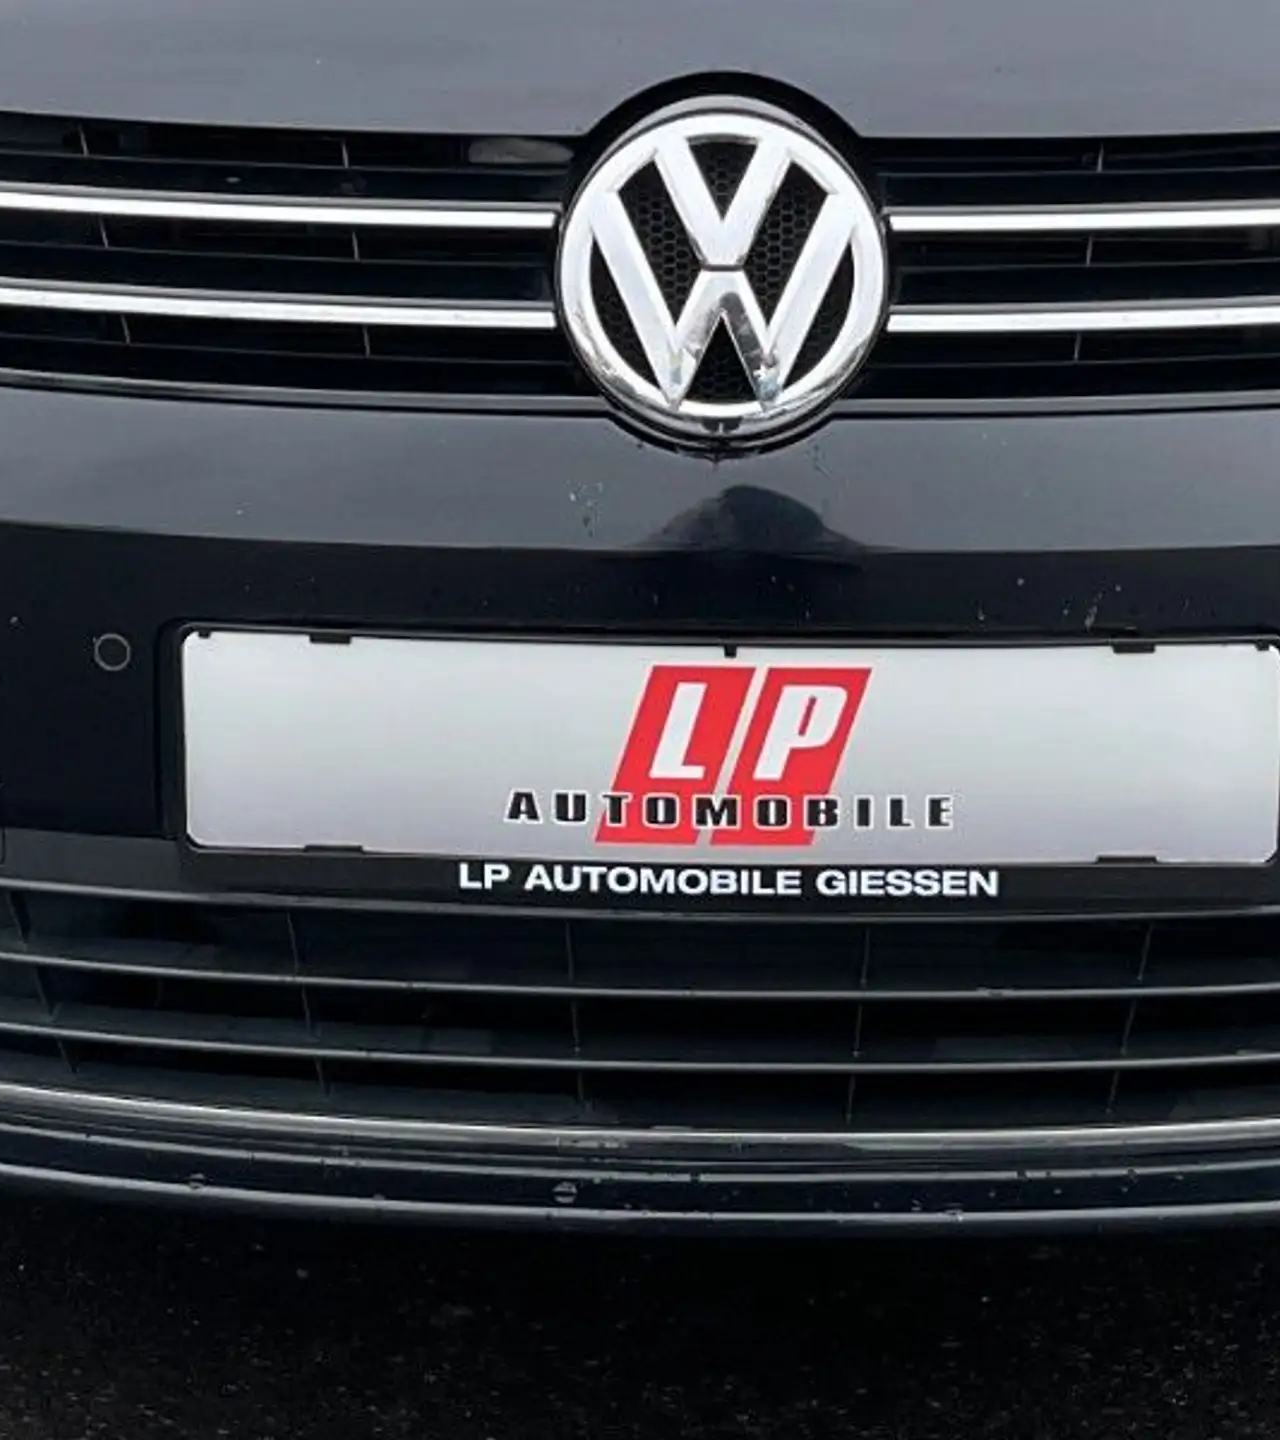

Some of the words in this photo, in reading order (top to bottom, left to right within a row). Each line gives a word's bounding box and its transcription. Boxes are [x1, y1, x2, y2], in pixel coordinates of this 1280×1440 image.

[648, 682, 848, 780] LP
[506, 790, 953, 829] AUTOMOBILE
[458, 862, 511, 891] LP
[524, 864, 803, 897] AUTOMOBILE
[815, 868, 999, 898] GIESSEN
